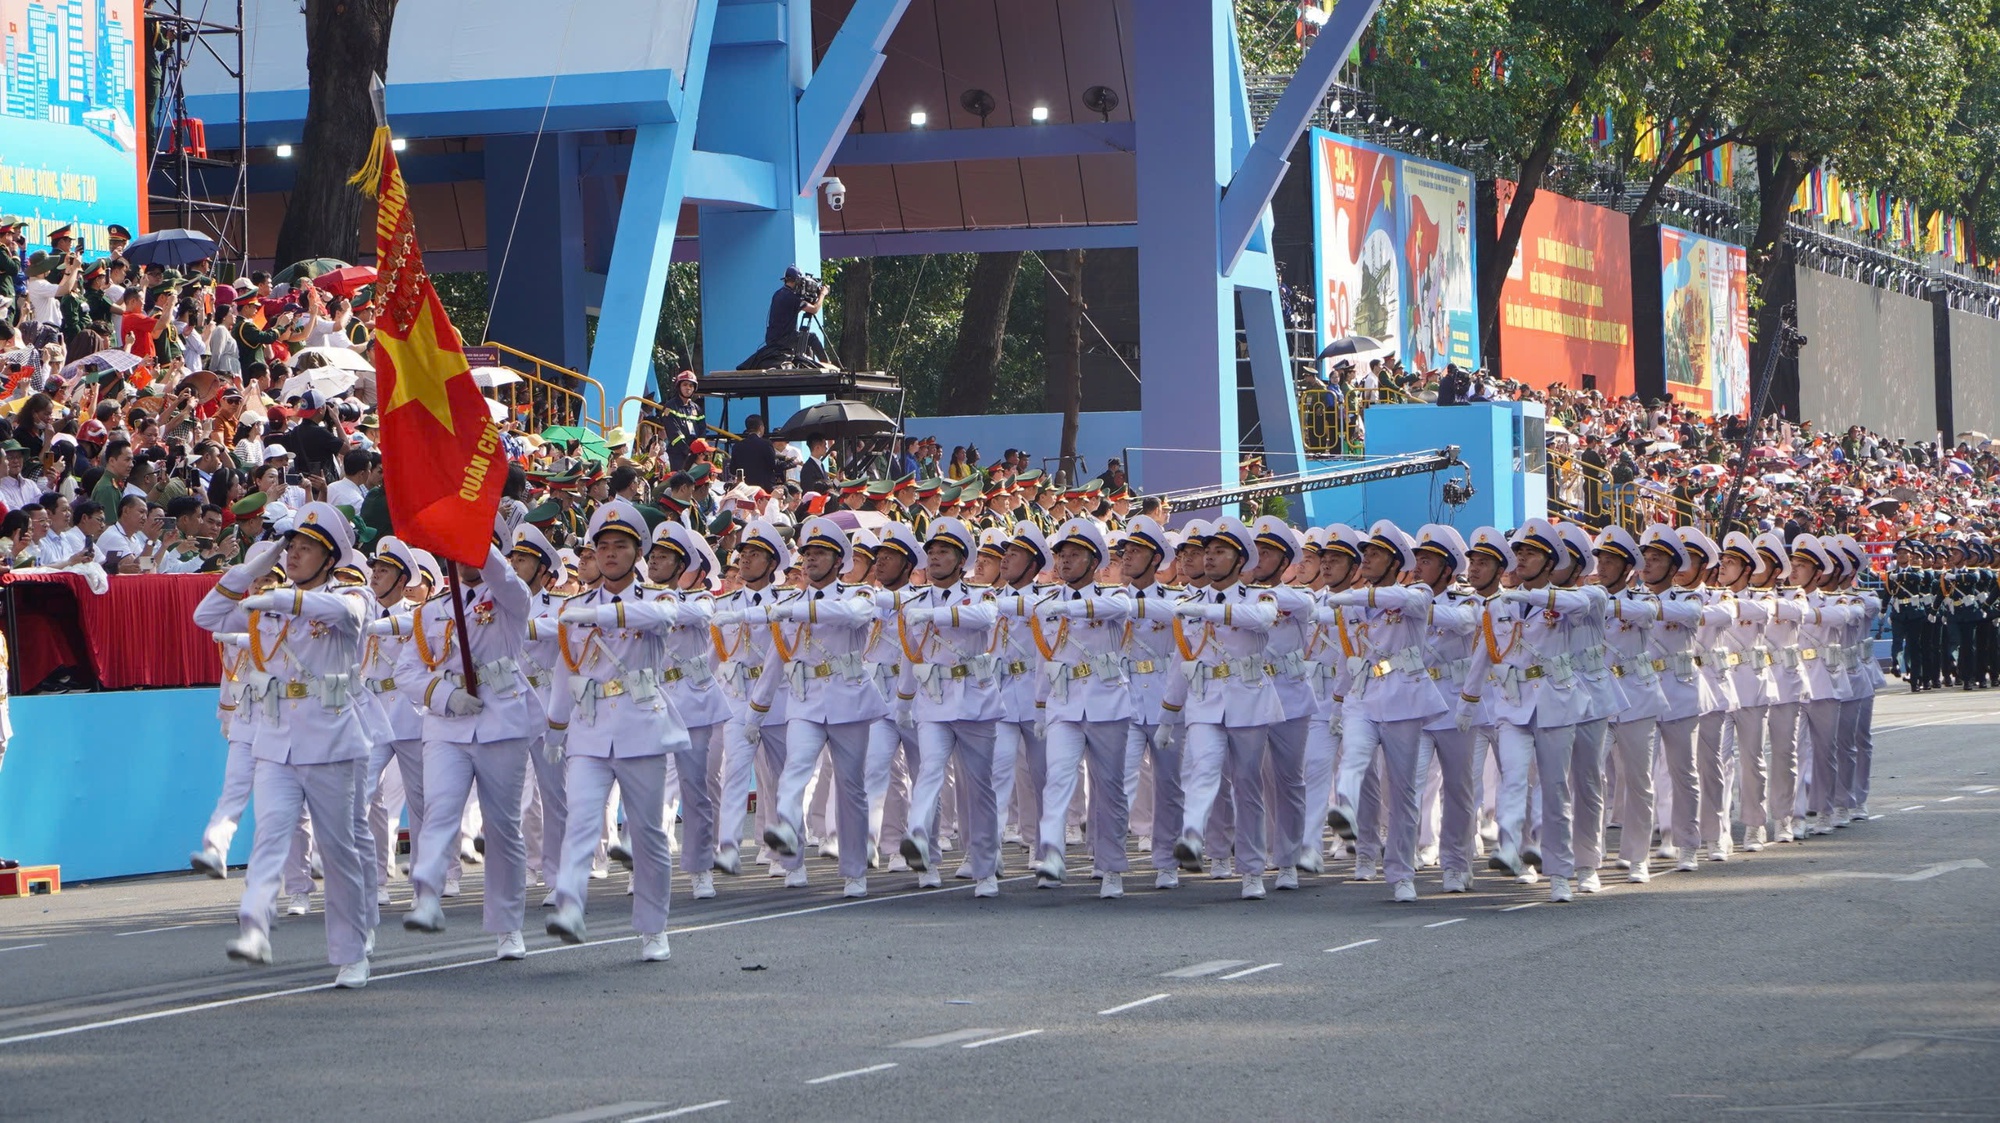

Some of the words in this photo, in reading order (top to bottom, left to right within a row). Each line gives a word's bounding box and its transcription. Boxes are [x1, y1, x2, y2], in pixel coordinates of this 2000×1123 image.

[1334, 146, 1355, 183] 30-4
[1329, 279, 1349, 338] 50
[459, 454, 491, 502] QUÂN
